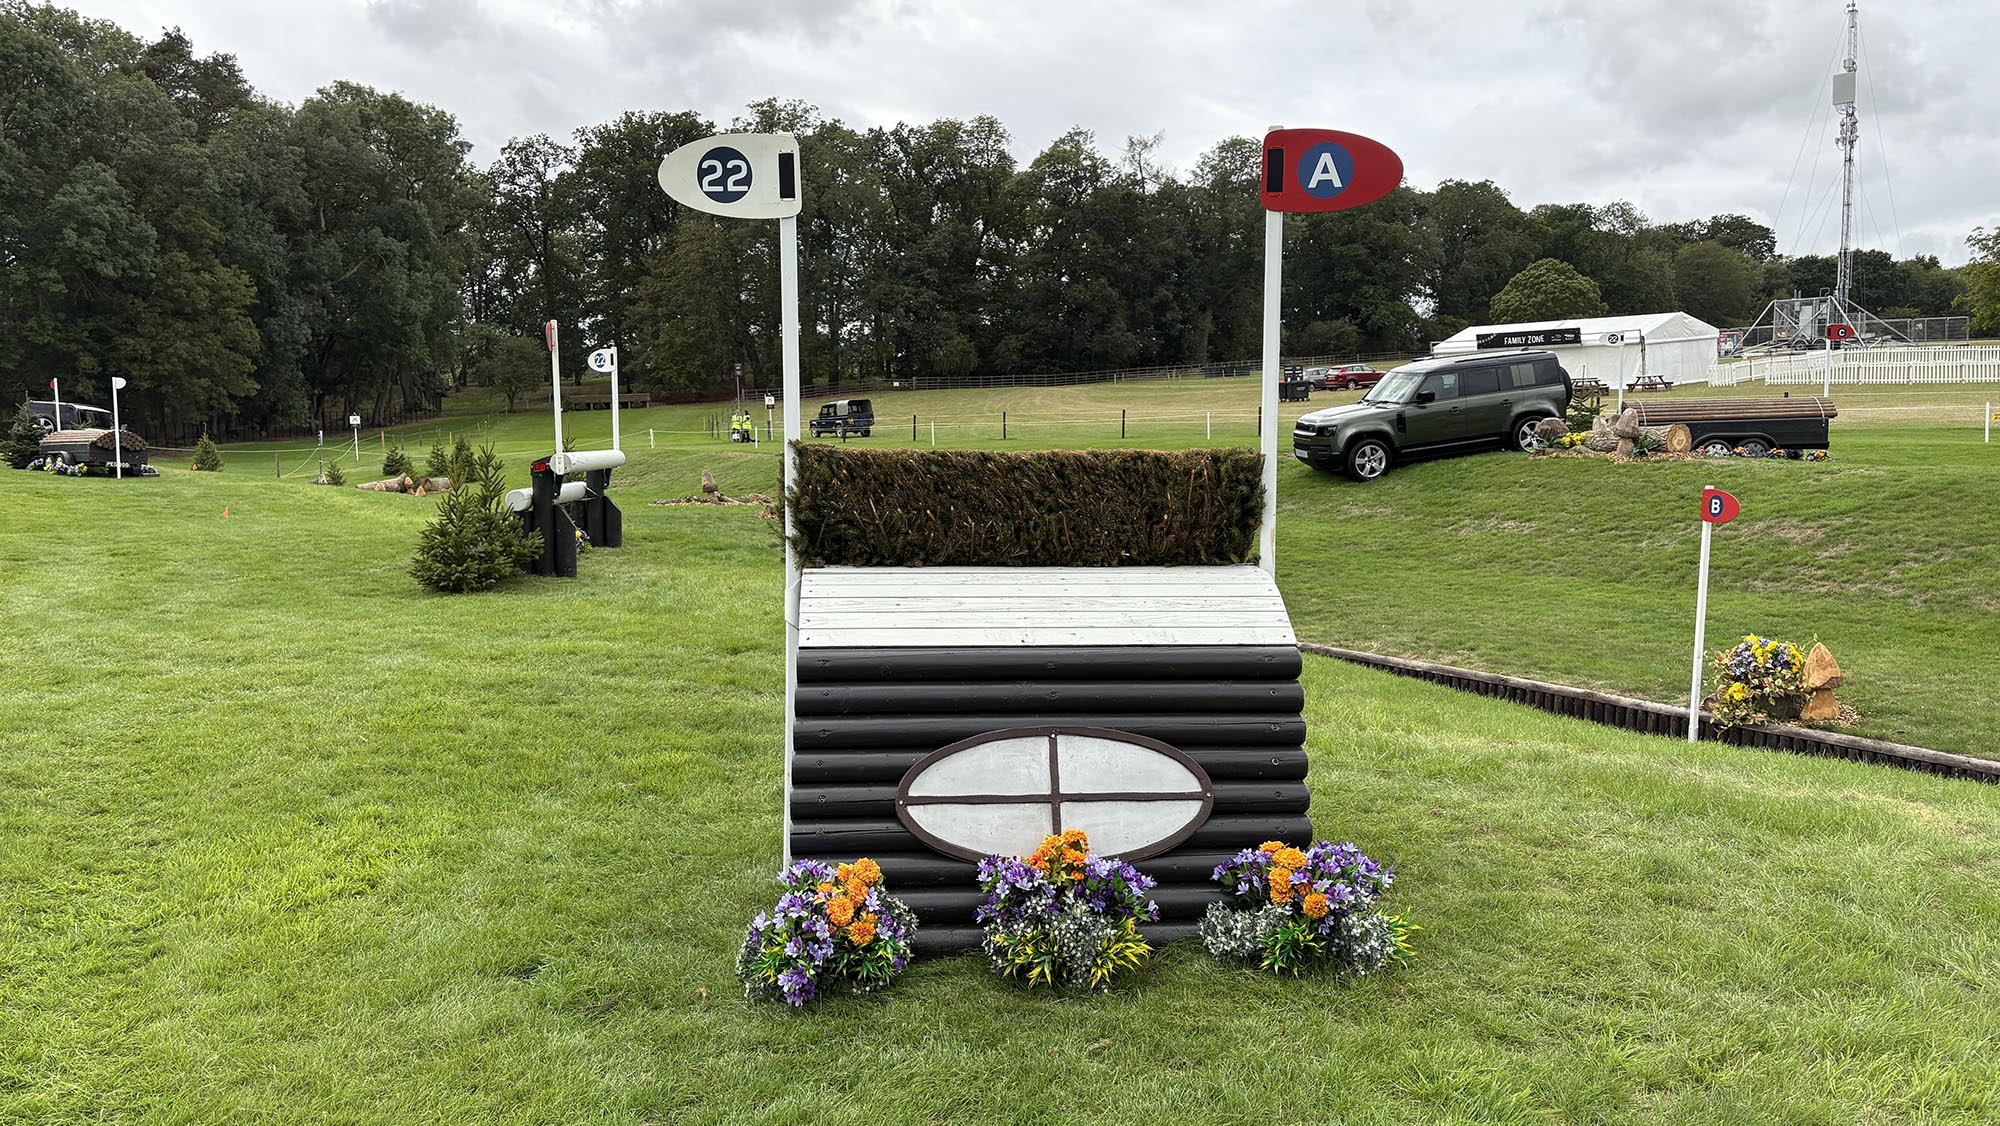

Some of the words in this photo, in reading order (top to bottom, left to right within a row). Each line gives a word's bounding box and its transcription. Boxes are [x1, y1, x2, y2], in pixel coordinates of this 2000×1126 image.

[702, 160, 748, 192] 22
[1308, 153, 1343, 188] A
[1838, 329, 1845, 337] C
[1504, 337, 1525, 345] FAMILY
[1527, 335, 1545, 344] ZONE
[595, 355, 605, 366] 22
[1711, 499, 1720, 514] B
